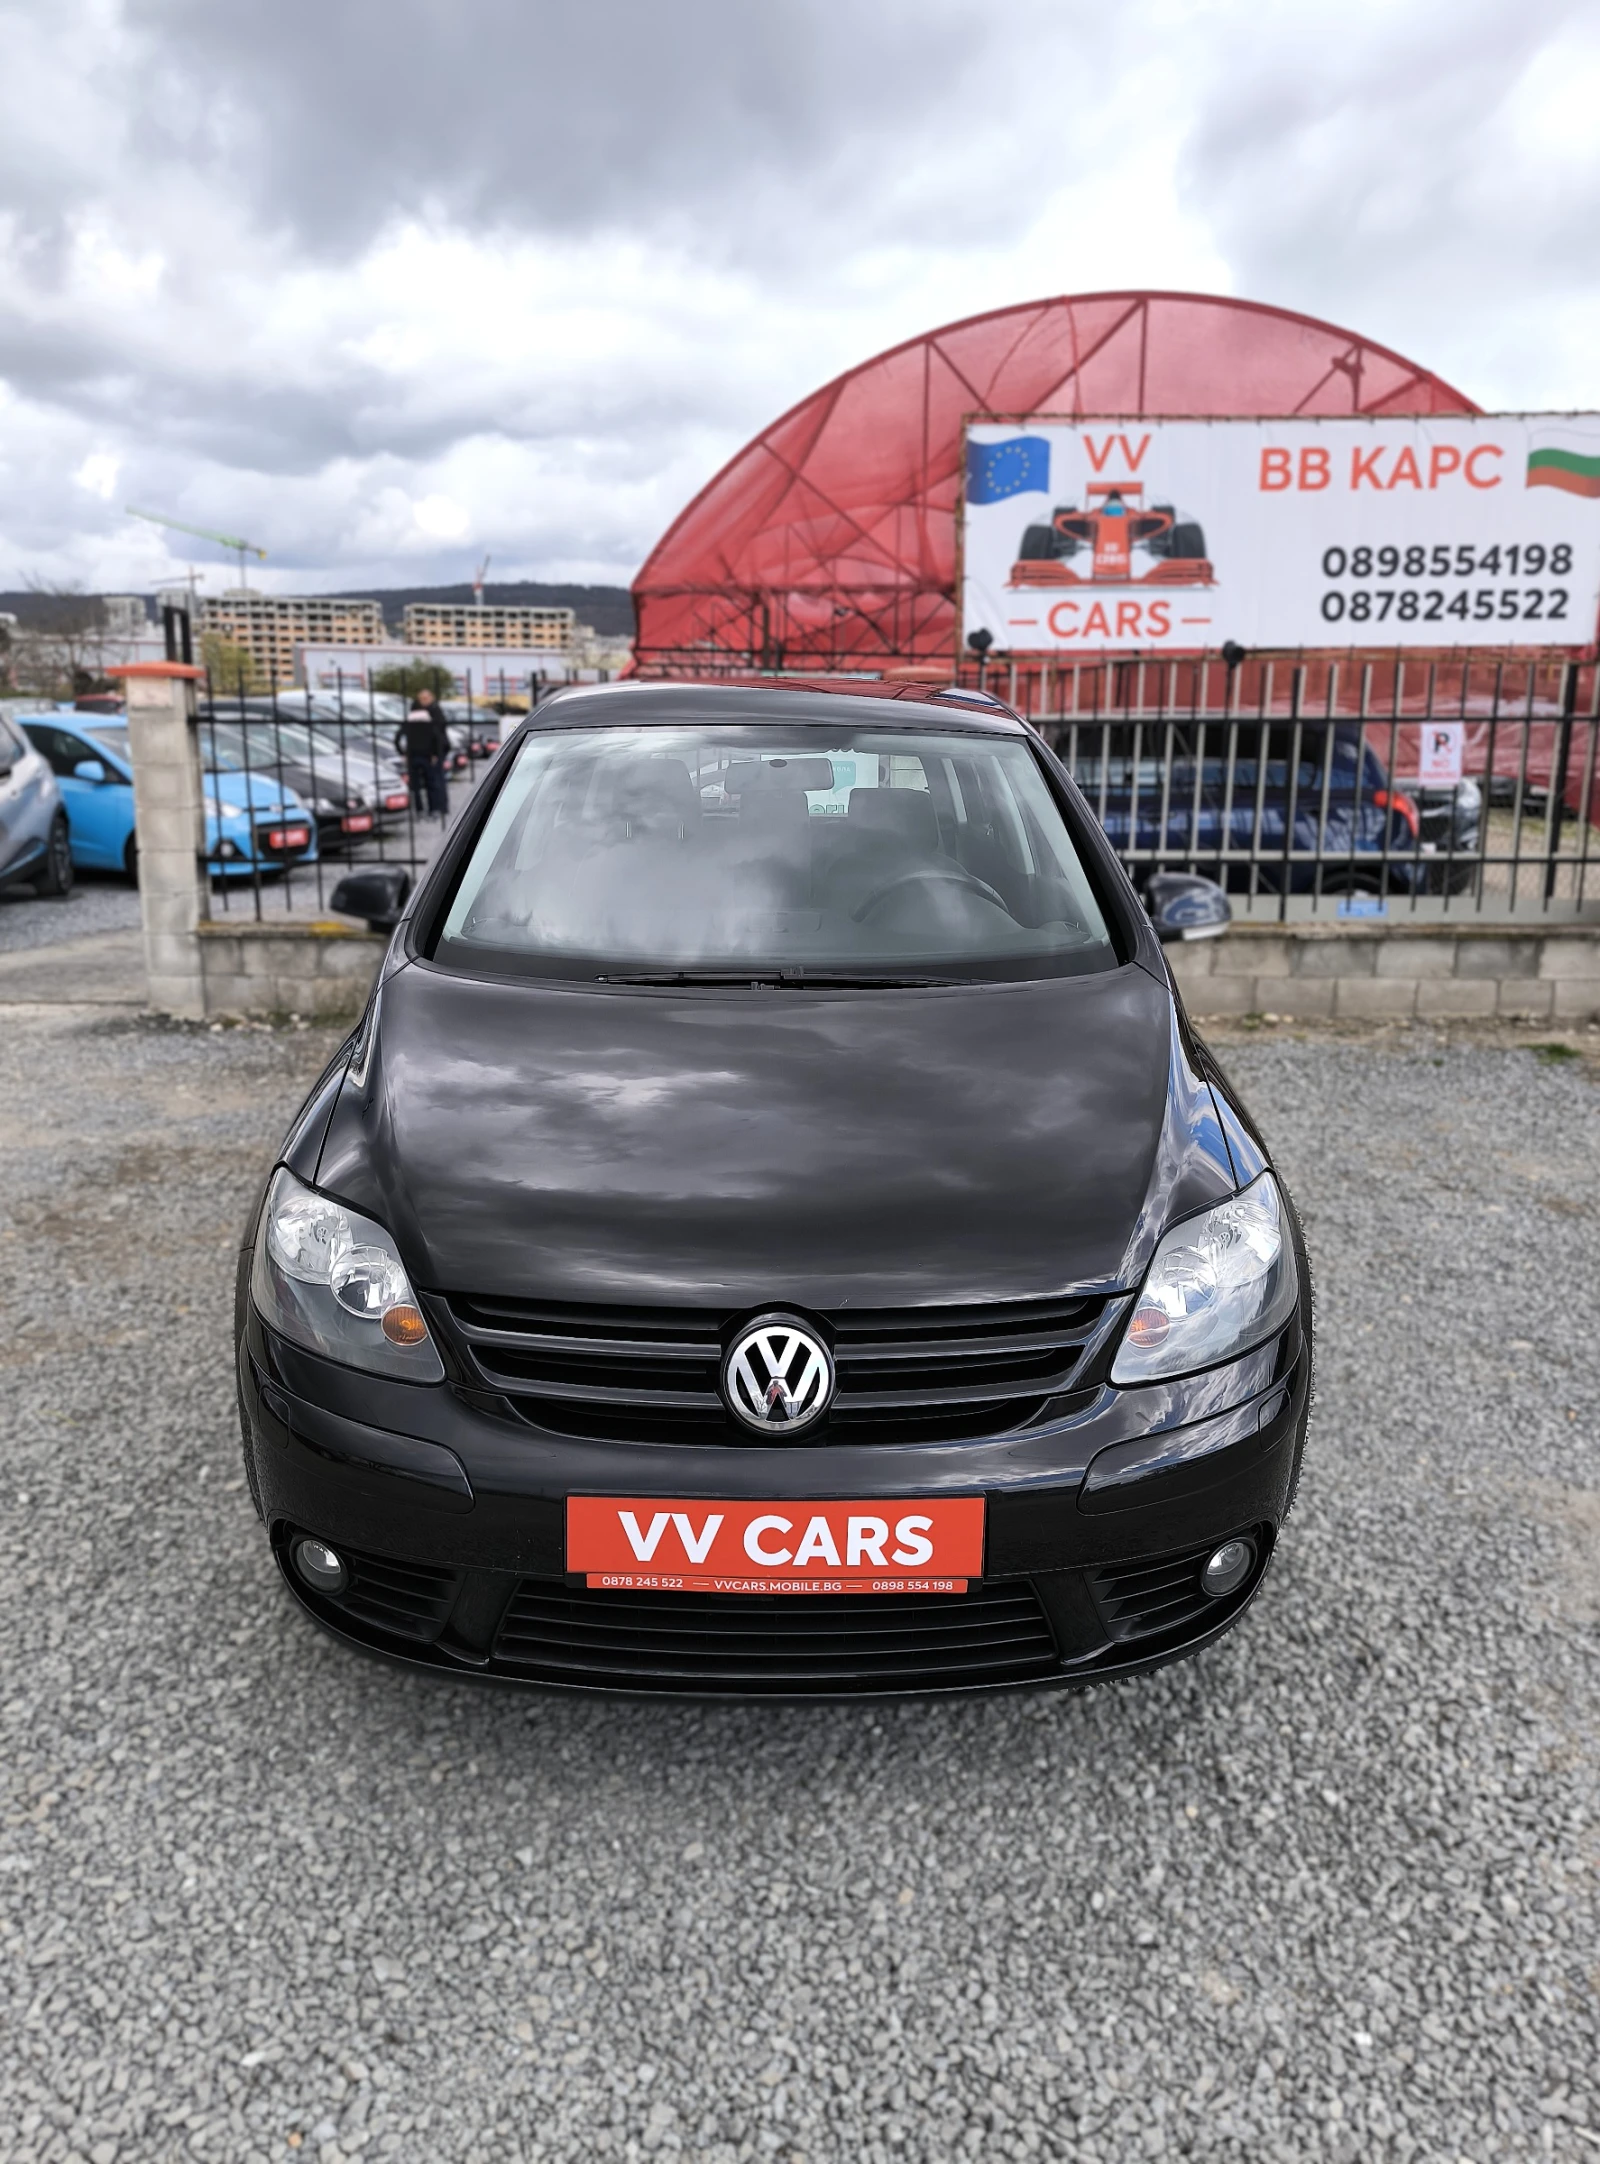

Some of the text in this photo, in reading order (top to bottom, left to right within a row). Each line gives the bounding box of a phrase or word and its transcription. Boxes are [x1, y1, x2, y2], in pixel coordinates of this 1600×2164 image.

[1082, 434, 1151, 473] VV
[1258, 443, 1504, 492] ВВ КАРС
[1321, 543, 1573, 578] 0898554198
[1047, 600, 1171, 639] CARS
[1320, 588, 1569, 623] 0878245522
[617, 1511, 934, 1566] VV CARS
[602, 1576, 953, 1592] 0878 245 522 VVCARS.MOBILE.BG 0898 554 198
